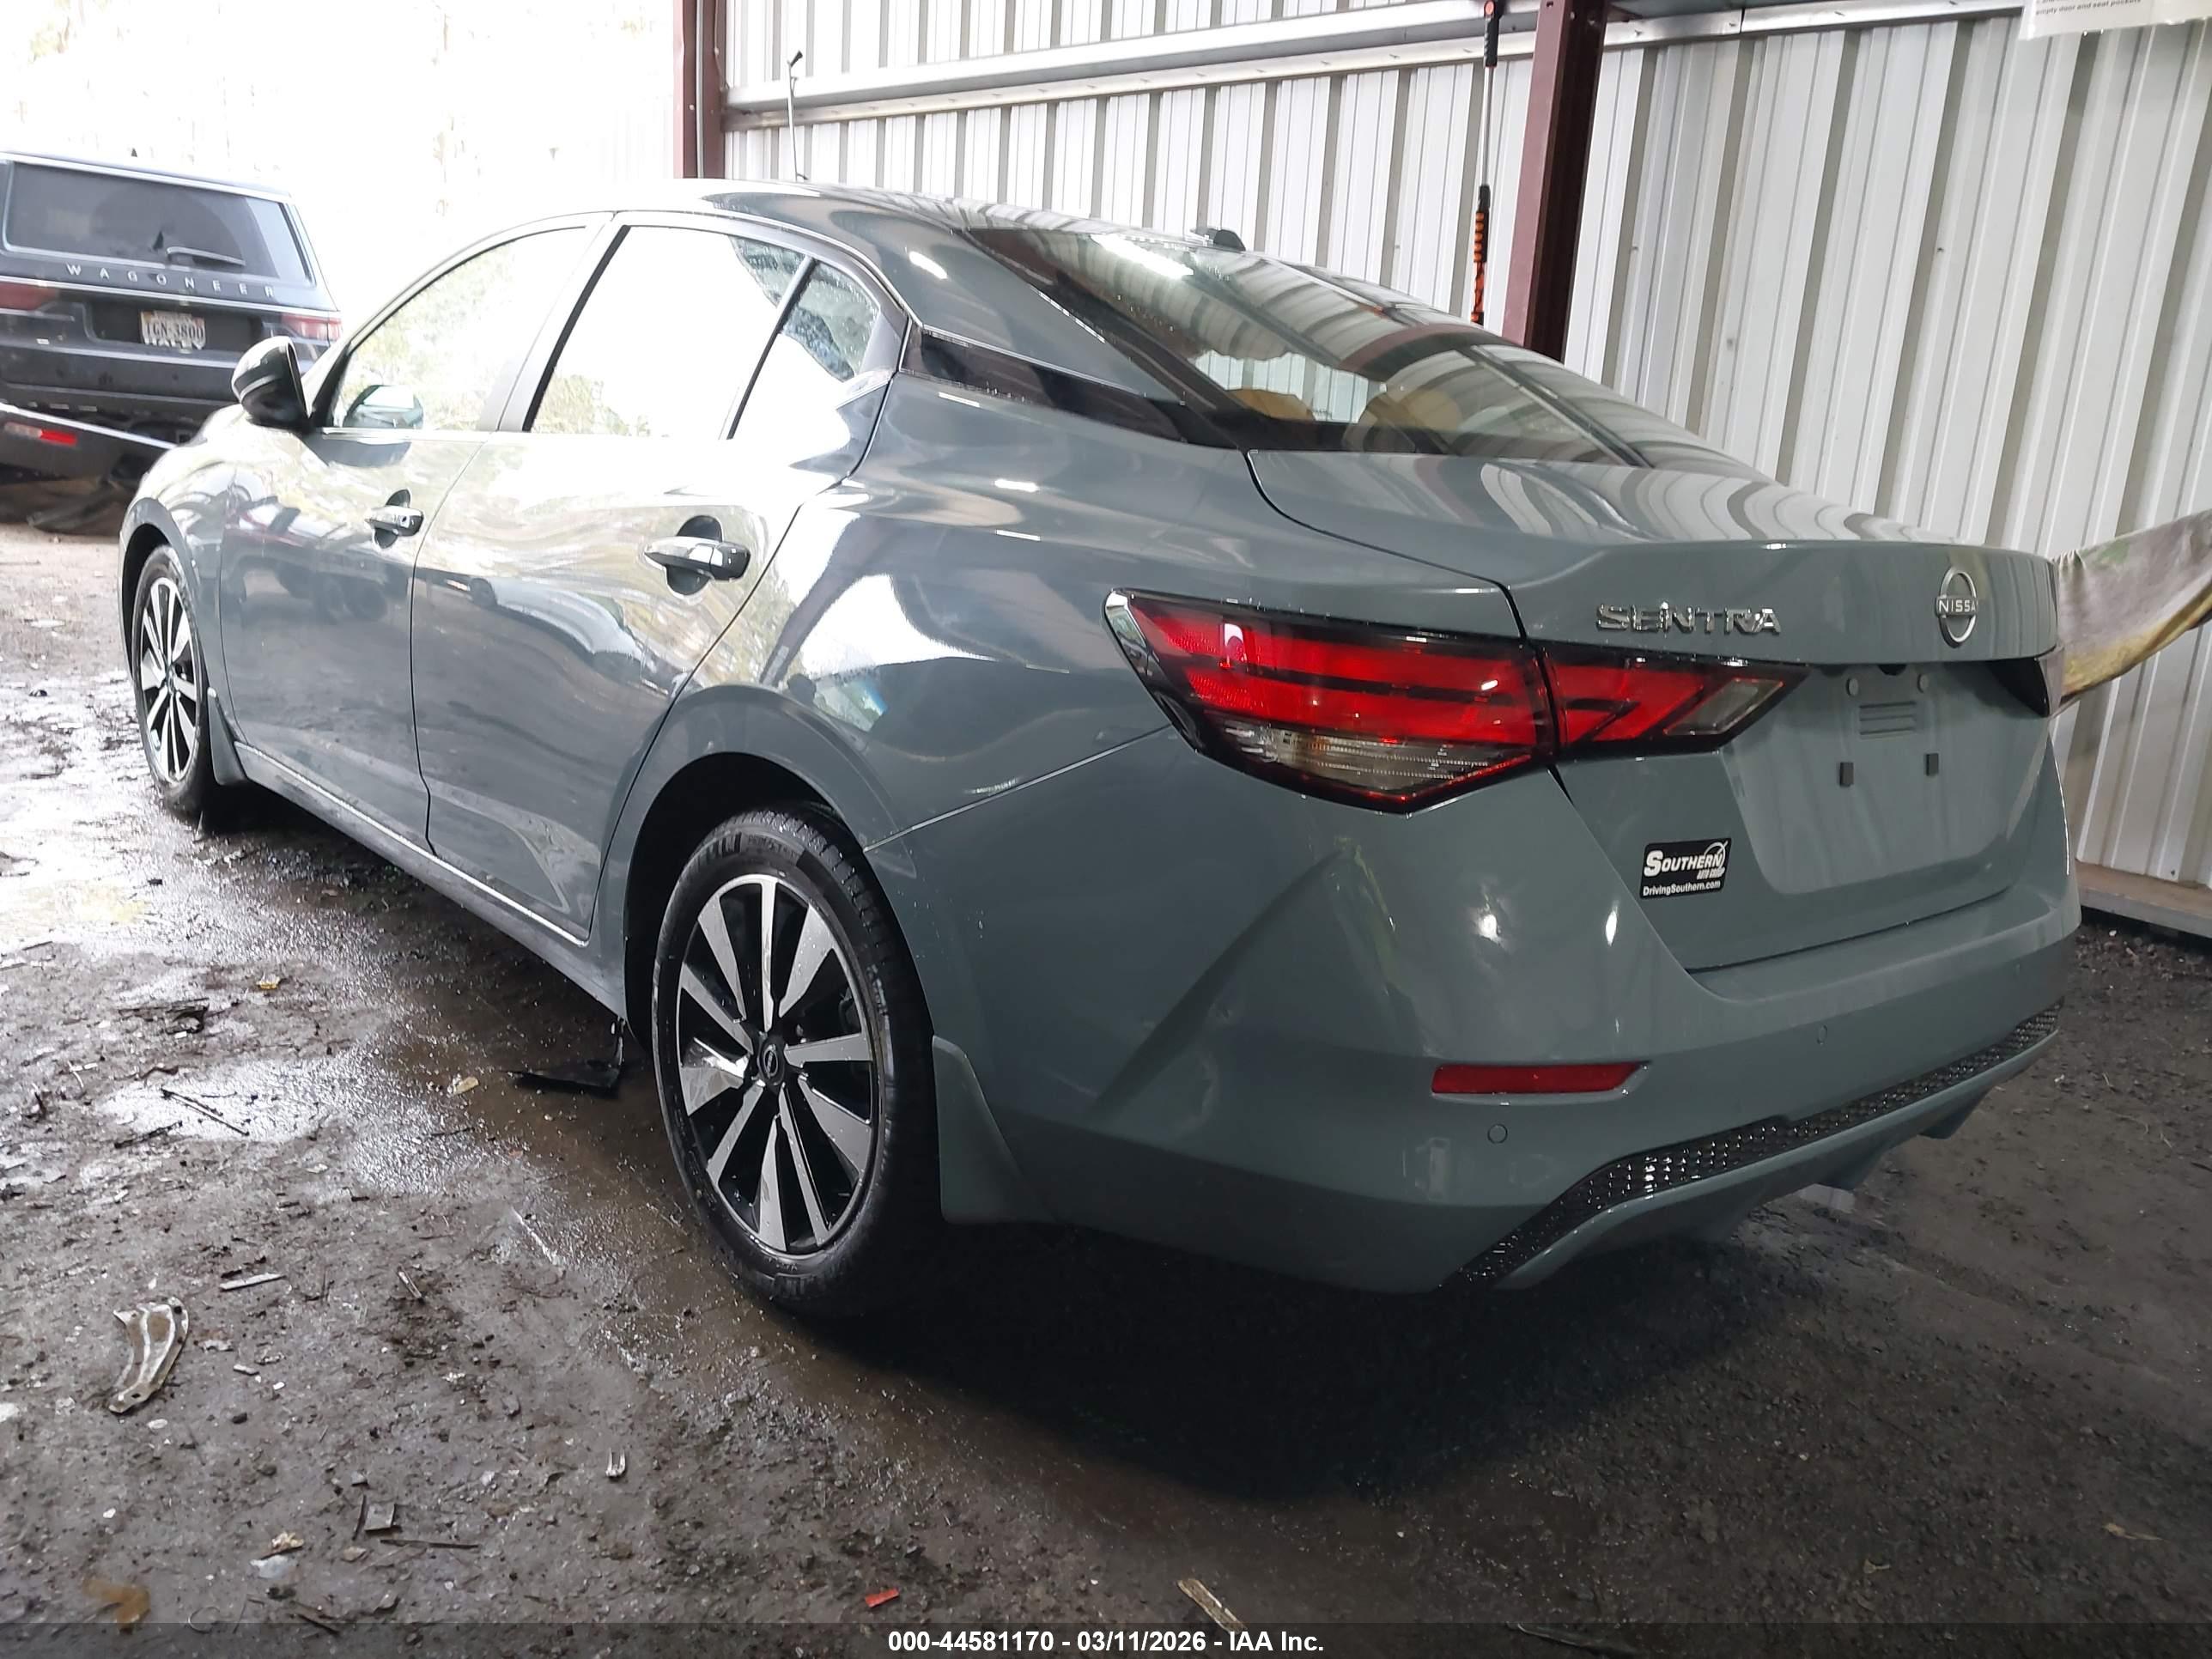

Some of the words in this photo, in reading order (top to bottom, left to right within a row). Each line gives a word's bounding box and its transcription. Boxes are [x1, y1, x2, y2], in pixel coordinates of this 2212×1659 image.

[66, 263, 275, 297] WAGONEER
[1596, 601, 1781, 635] SENTRA
[1643, 880, 1721, 896] DrivingSouthern.com
